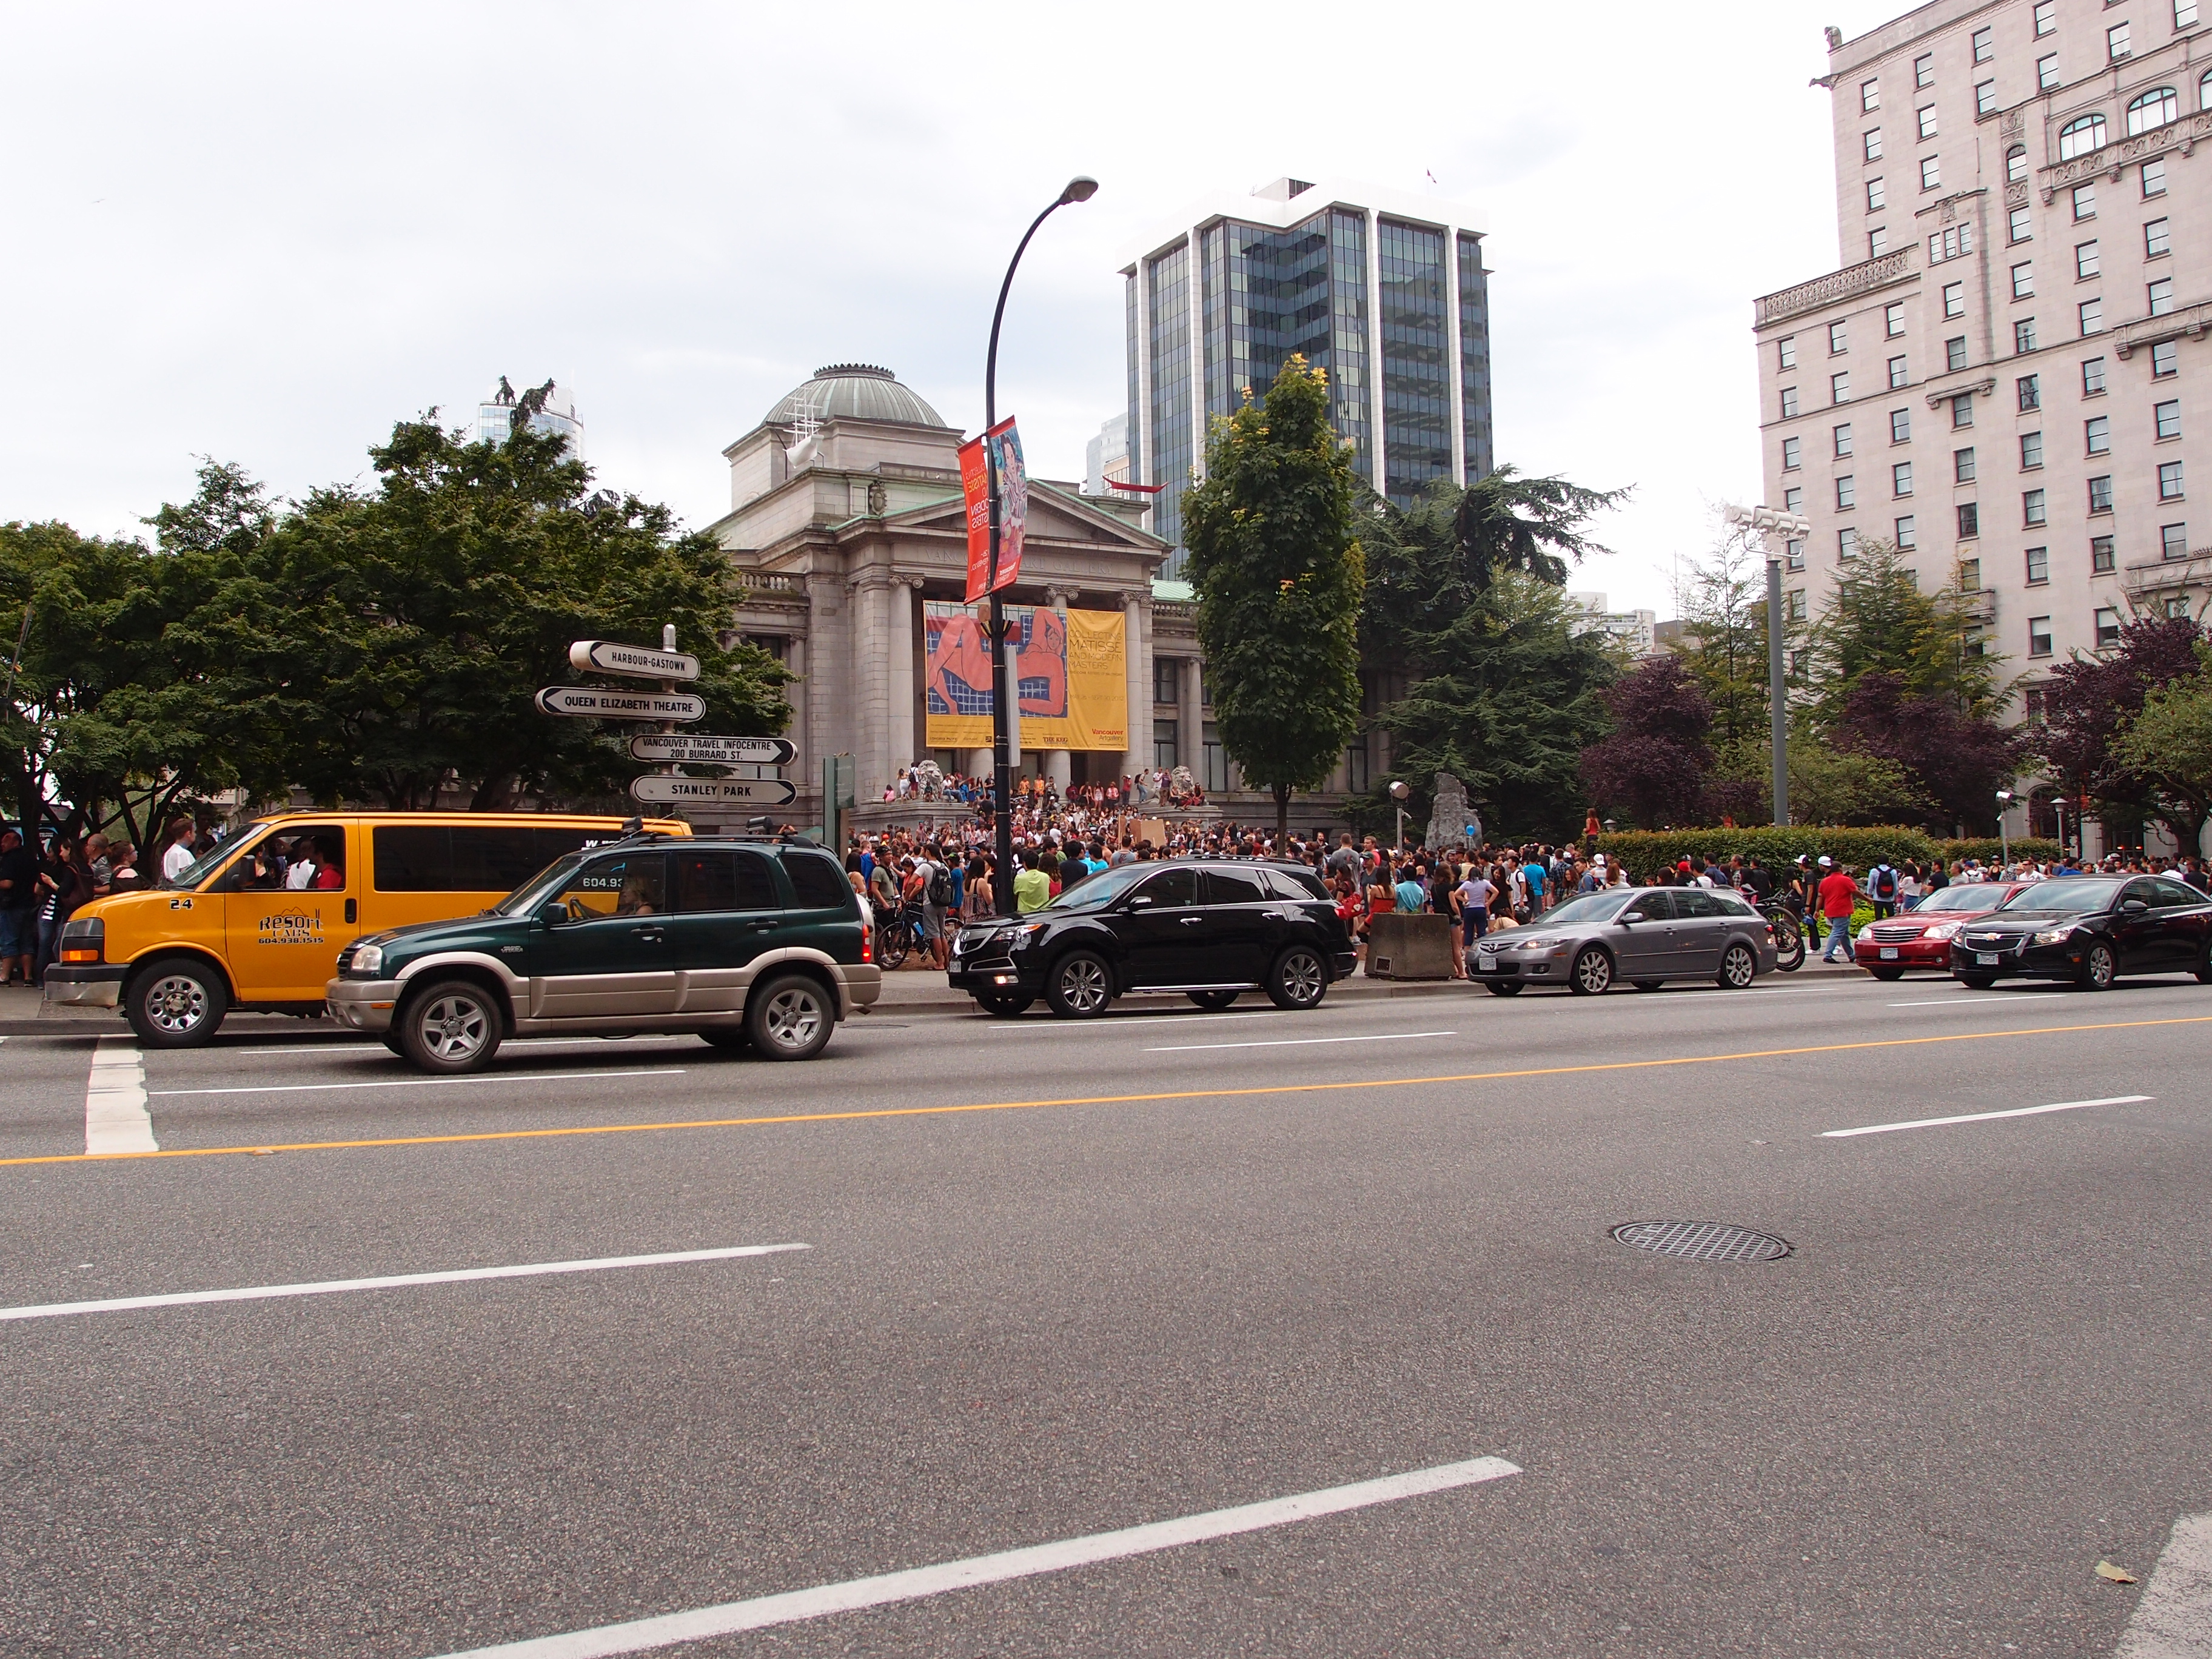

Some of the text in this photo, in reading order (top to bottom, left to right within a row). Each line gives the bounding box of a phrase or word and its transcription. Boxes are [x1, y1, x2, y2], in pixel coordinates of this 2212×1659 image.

[1053, 560, 1113, 575] GALLERY
[1068, 630, 1122, 640] COLLECTING
[1069, 639, 1122, 653] MATISSE
[612, 652, 685, 671] HARBOUR-GASTOWN
[1068, 661, 1108, 669] MASTERS
[565, 696, 693, 712] QUEEN ELIZABETH THEATRE
[643, 738, 771, 751] VANCOUVER TRAVEL INFOCENTRE
[670, 749, 743, 760] 200 BURRARD ST.
[671, 785, 751, 797] STANLEY PARK
[170, 899, 193, 910] 24
[273, 929, 310, 938] CABS
